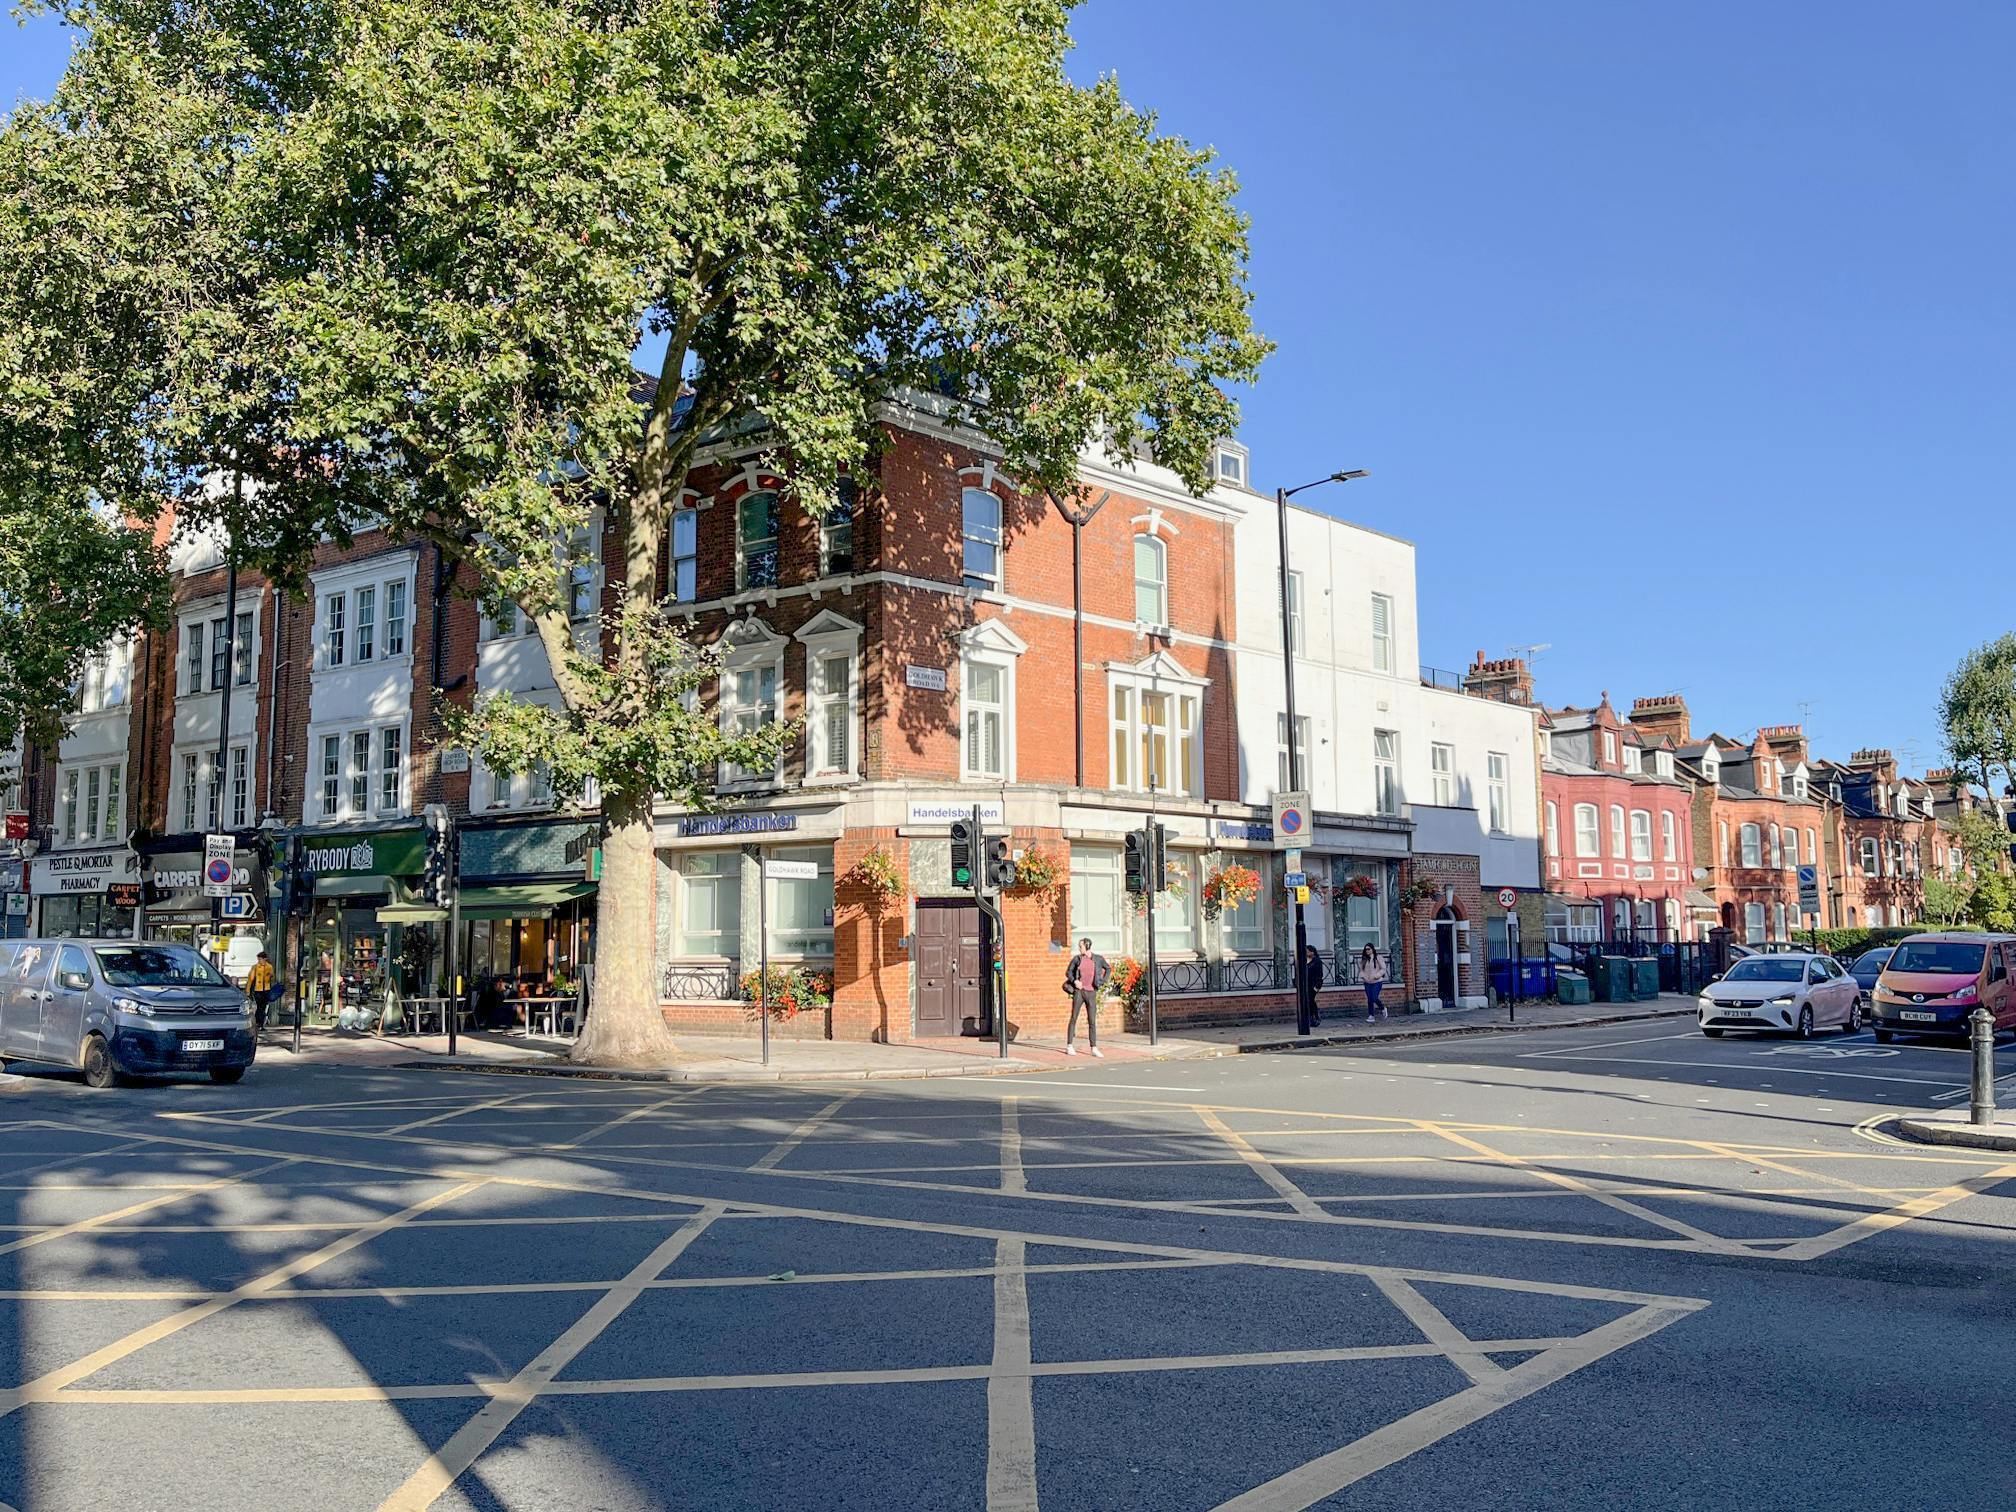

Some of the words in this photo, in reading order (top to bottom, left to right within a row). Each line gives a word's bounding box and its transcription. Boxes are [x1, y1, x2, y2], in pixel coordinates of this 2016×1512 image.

[913, 808, 998, 818] Handelsbaken
[681, 813, 798, 835] Handelsbanken
[49, 858, 73, 871] PESTLE
[82, 855, 114, 869] MORTAR
[305, 847, 350, 872] RYBODY
[61, 877, 101, 890] PHARMACY
[154, 870, 201, 888] CARPET
[110, 884, 140, 893] CARPET
[1500, 893, 1514, 902] 20
[229, 898, 240, 913] P
[189, 1041, 206, 1049] DY71
